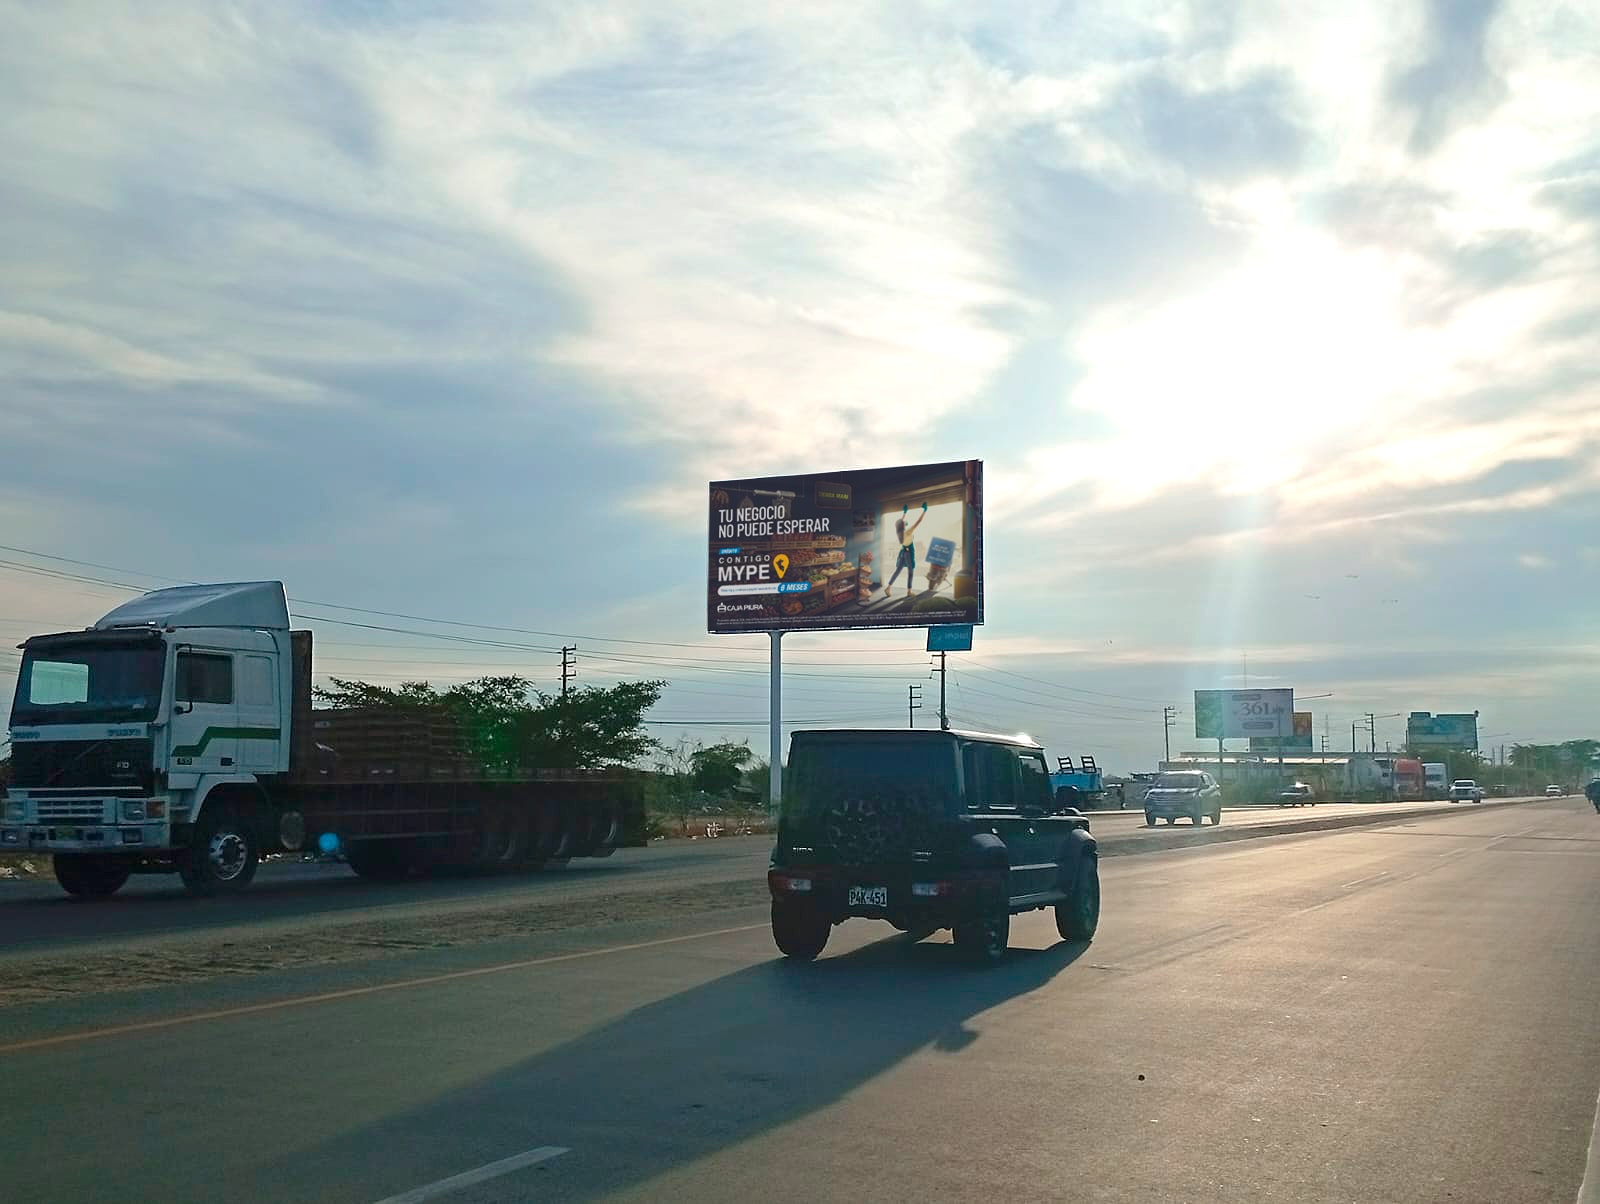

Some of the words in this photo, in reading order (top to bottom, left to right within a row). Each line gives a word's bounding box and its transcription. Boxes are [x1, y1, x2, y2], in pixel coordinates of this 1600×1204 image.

[718, 509, 733, 523] TU
[736, 505, 785, 522] NEGOCIO
[718, 524, 734, 539] NO
[737, 521, 774, 537] PUEDE
[776, 517, 830, 535] ESPERAR
[718, 554, 771, 564] CONTIGO
[718, 564, 770, 582] MYPE
[780, 584, 785, 592] 6
[786, 583, 808, 591] MESES
[743, 603, 764, 611] PIURA
